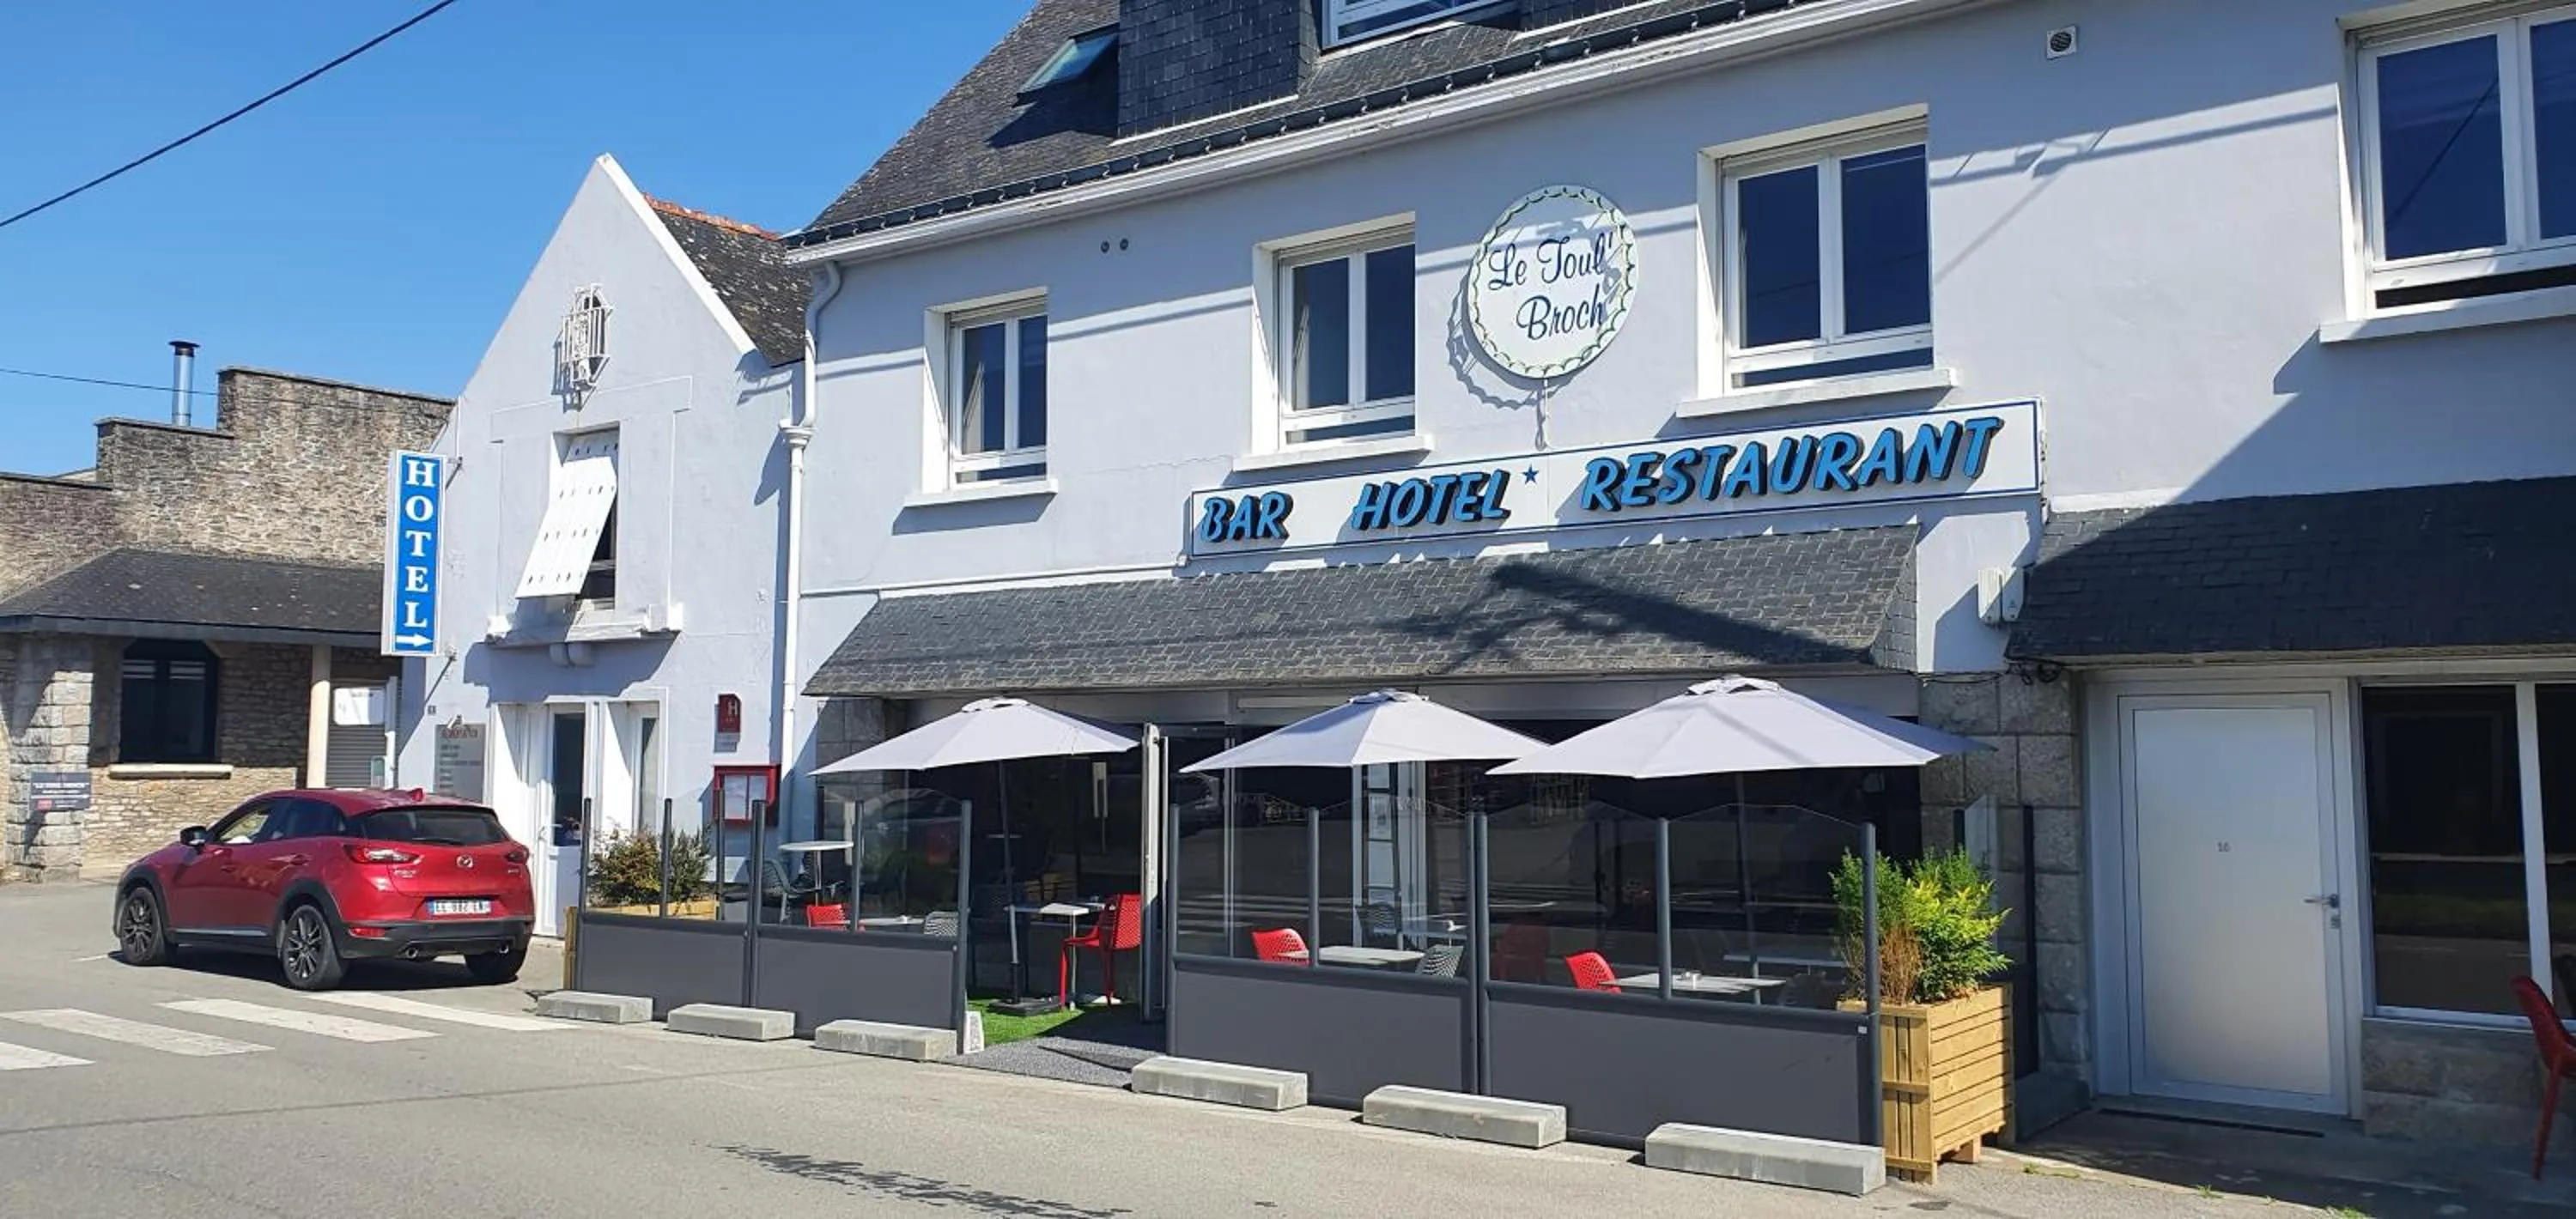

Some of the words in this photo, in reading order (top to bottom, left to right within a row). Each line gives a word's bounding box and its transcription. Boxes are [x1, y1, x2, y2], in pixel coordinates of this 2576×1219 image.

[1488, 242, 1528, 291] Le
[1203, 490, 1293, 543] BAR
[1351, 468, 1511, 531] HOTEL
[1581, 416, 2004, 512] RESTAURANT
[404, 459, 436, 628] HOTEL
